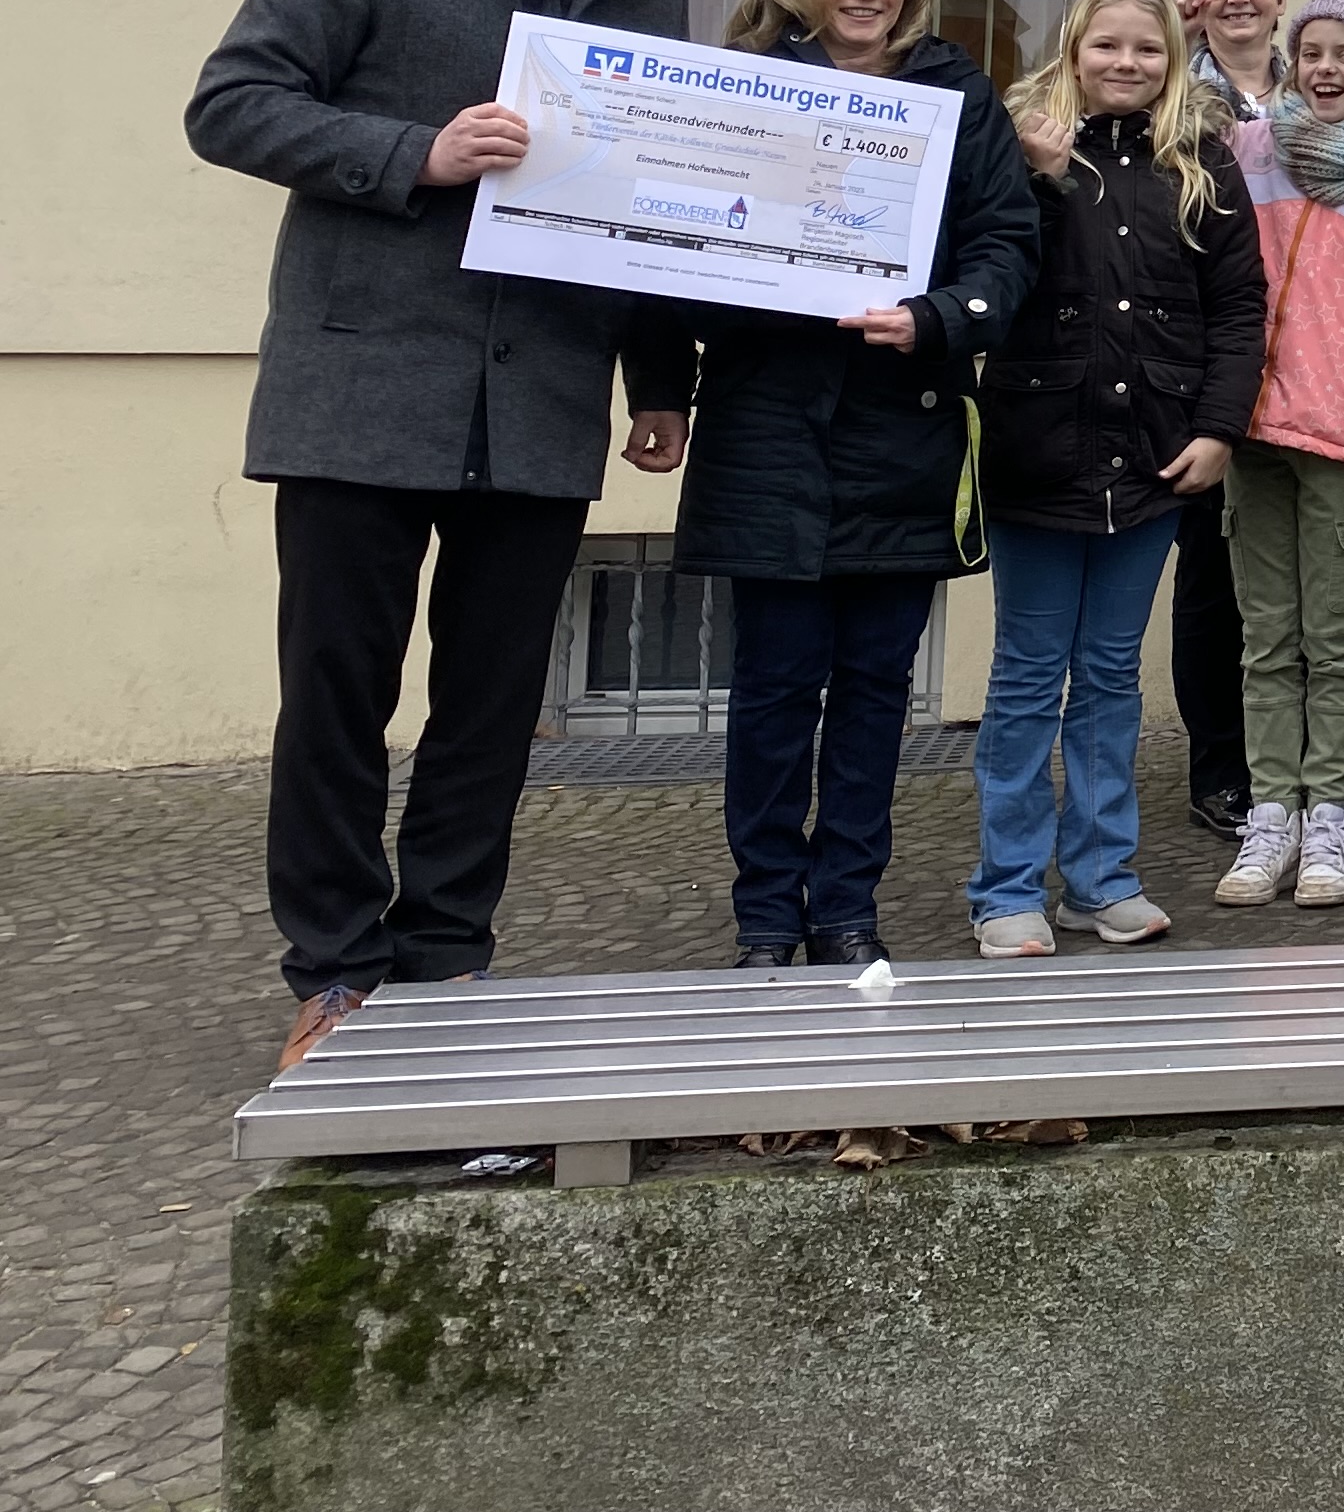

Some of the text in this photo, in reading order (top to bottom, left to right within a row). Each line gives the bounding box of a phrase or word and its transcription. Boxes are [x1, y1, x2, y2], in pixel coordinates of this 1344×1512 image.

[539, 90, 574, 109] DE
[641, 57, 910, 124] Brandenburger Bank
[822, 133, 909, 160] € 1.400,00
[636, 152, 751, 180] Einnahmen Hofweihnacht
